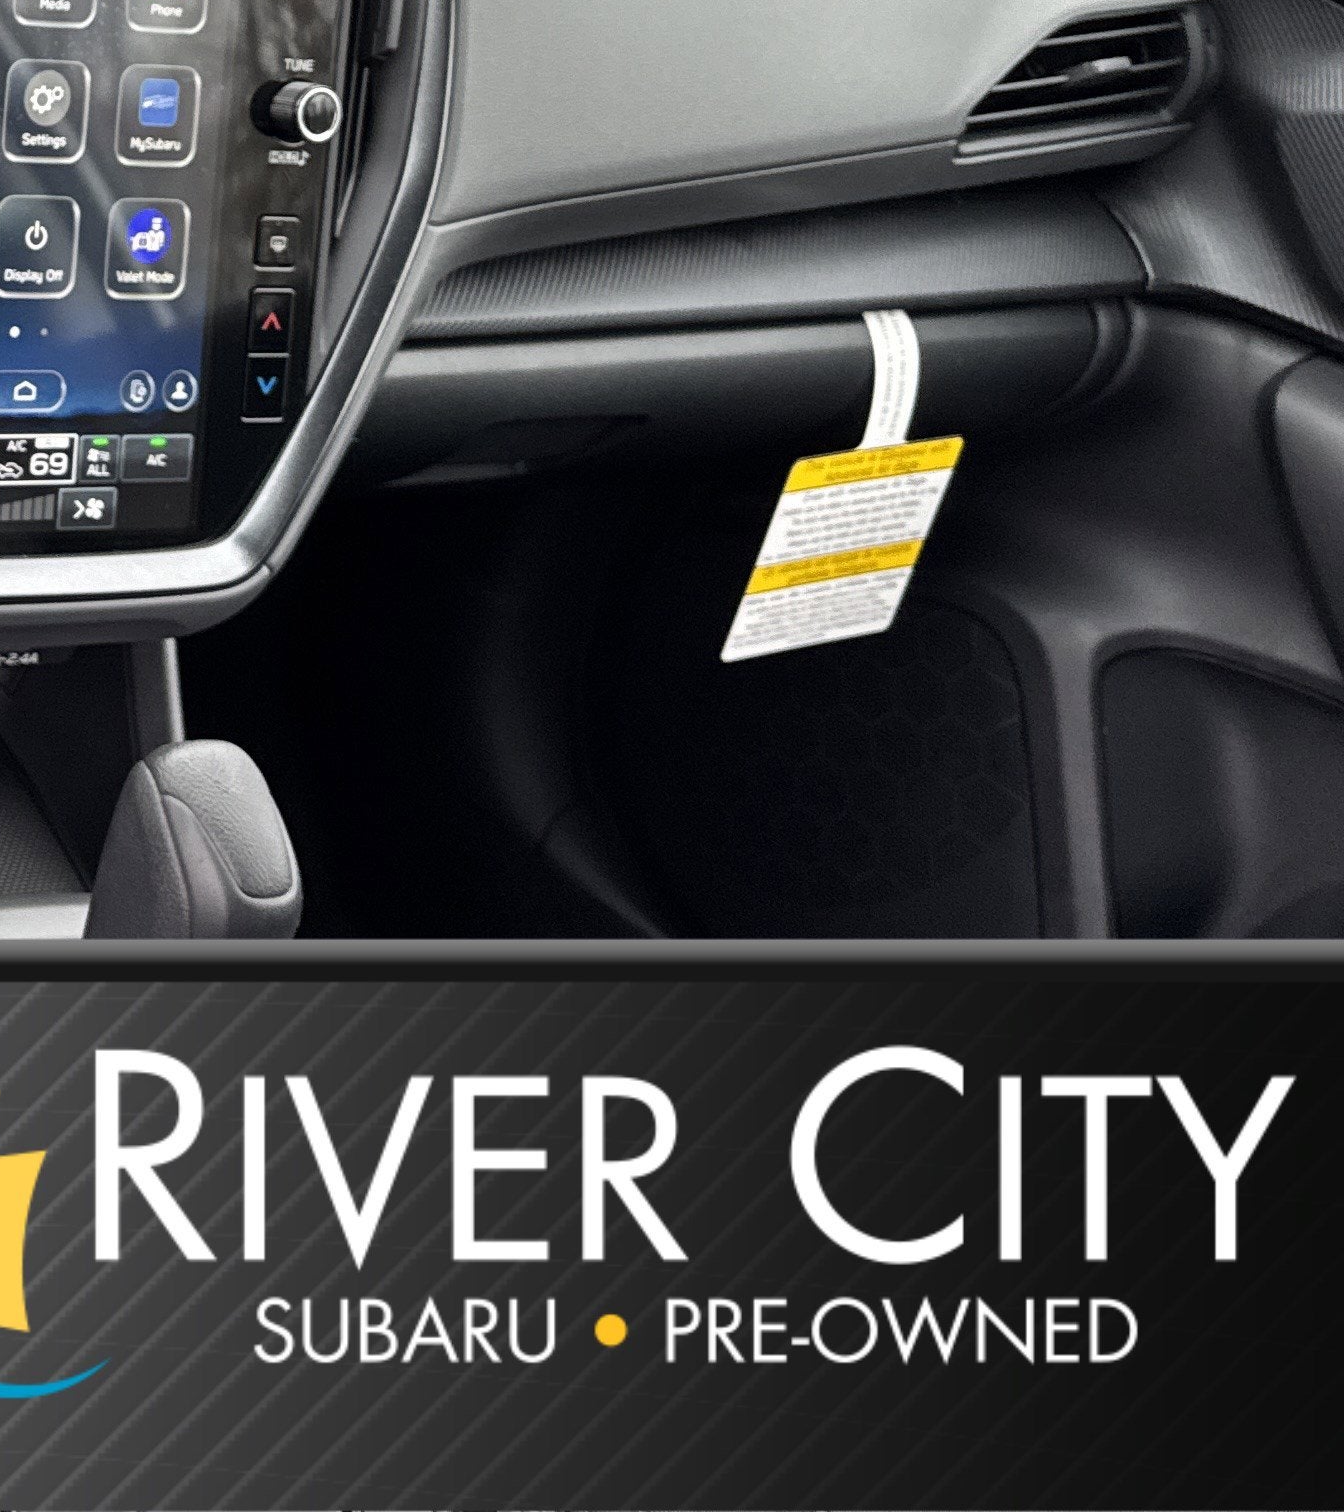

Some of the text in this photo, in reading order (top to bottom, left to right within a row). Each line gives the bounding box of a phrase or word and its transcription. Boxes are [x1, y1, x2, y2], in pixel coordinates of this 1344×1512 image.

[150, 3, 183, 17] Phone
[284, 57, 315, 73] TUNE
[22, 132, 67, 150] Settings
[130, 136, 182, 153] MySubaru
[4, 268, 64, 285] Display Off
[116, 270, 176, 285] Valet Mode
[29, 452, 68, 476] 69
[86, 463, 110, 477] ALL
